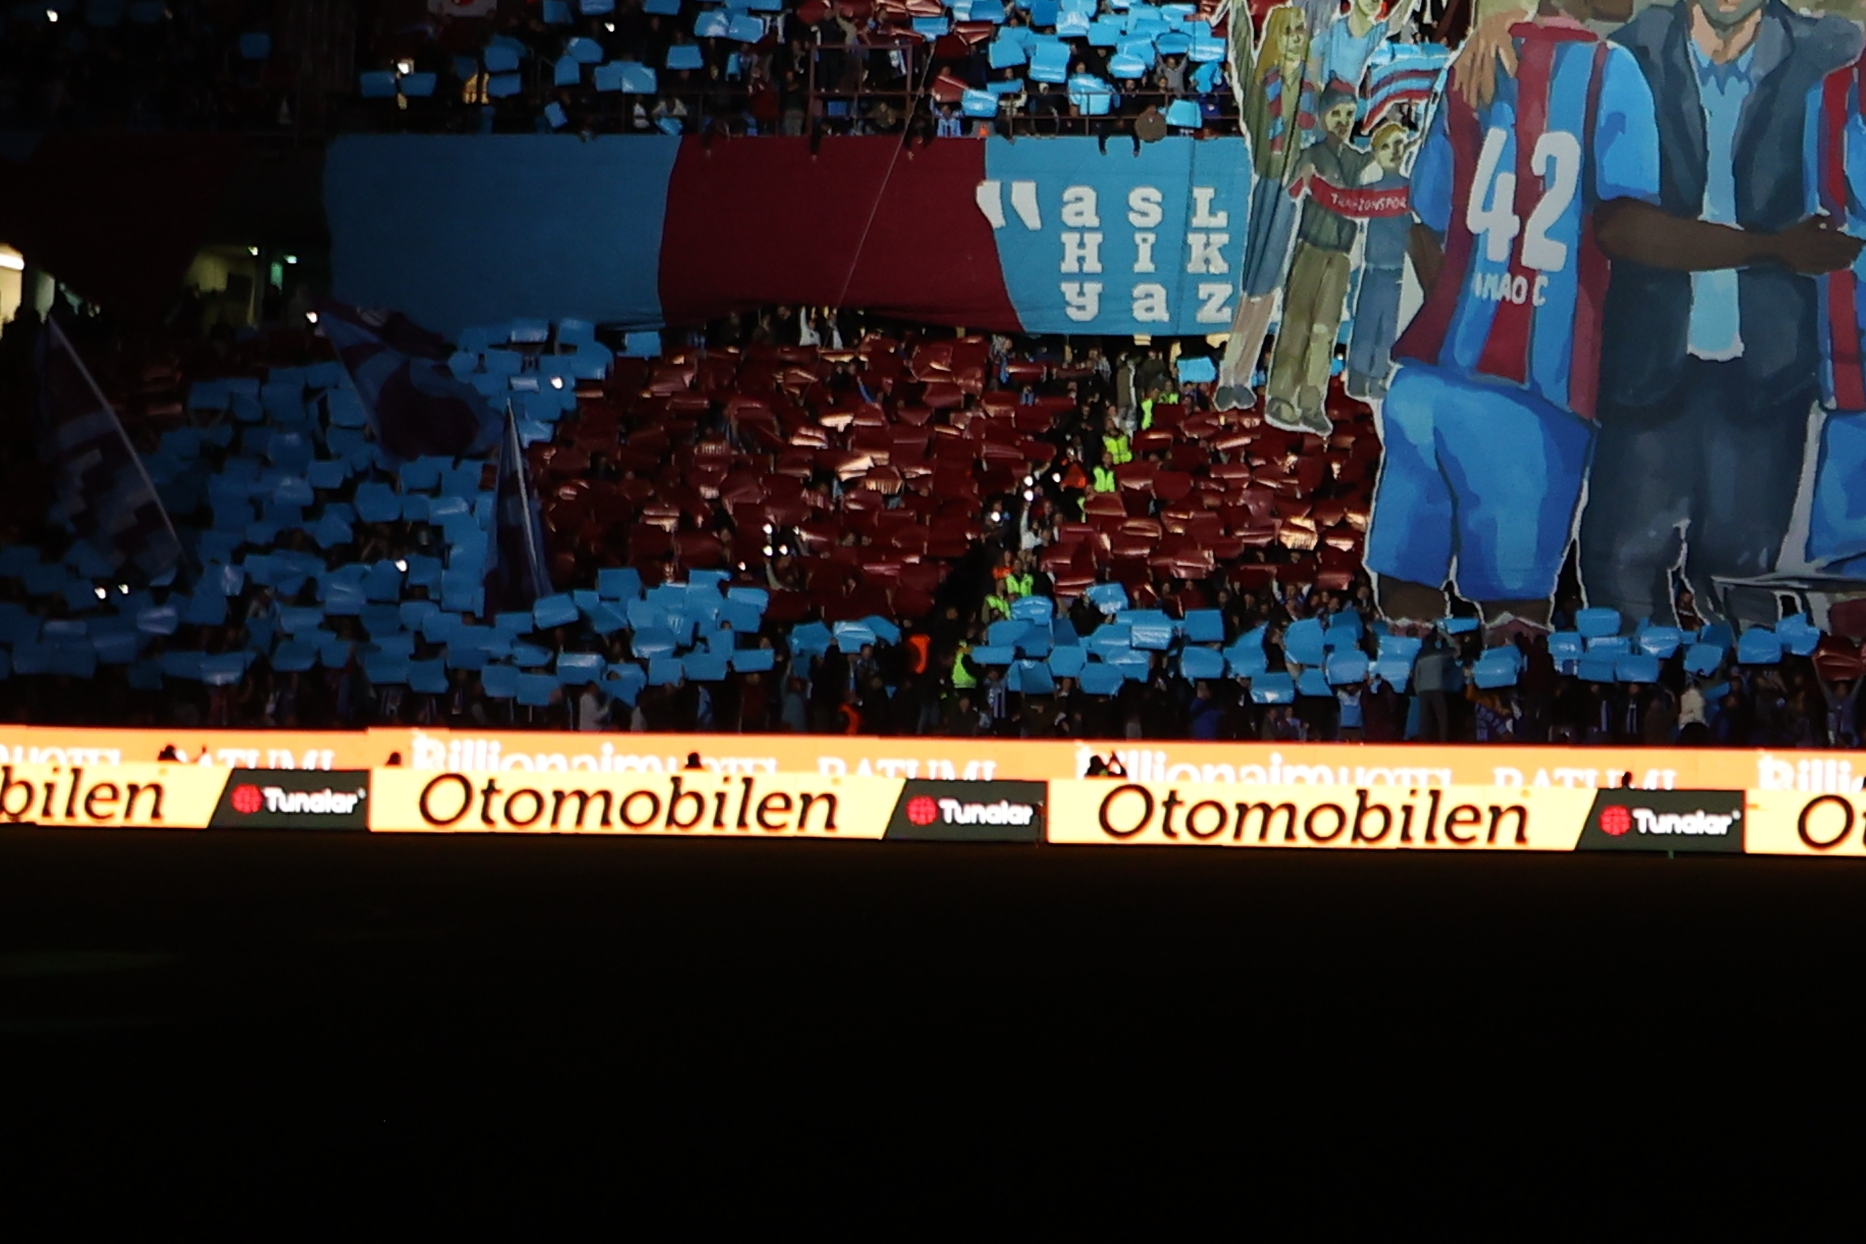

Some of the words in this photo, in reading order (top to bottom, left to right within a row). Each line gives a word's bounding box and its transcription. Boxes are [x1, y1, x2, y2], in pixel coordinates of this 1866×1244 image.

[1466, 126, 1582, 273] 42
[419, 772, 838, 833] Otomobilen
[938, 797, 1035, 825] Tunalar
[1099, 783, 1529, 846] Otomobilen
